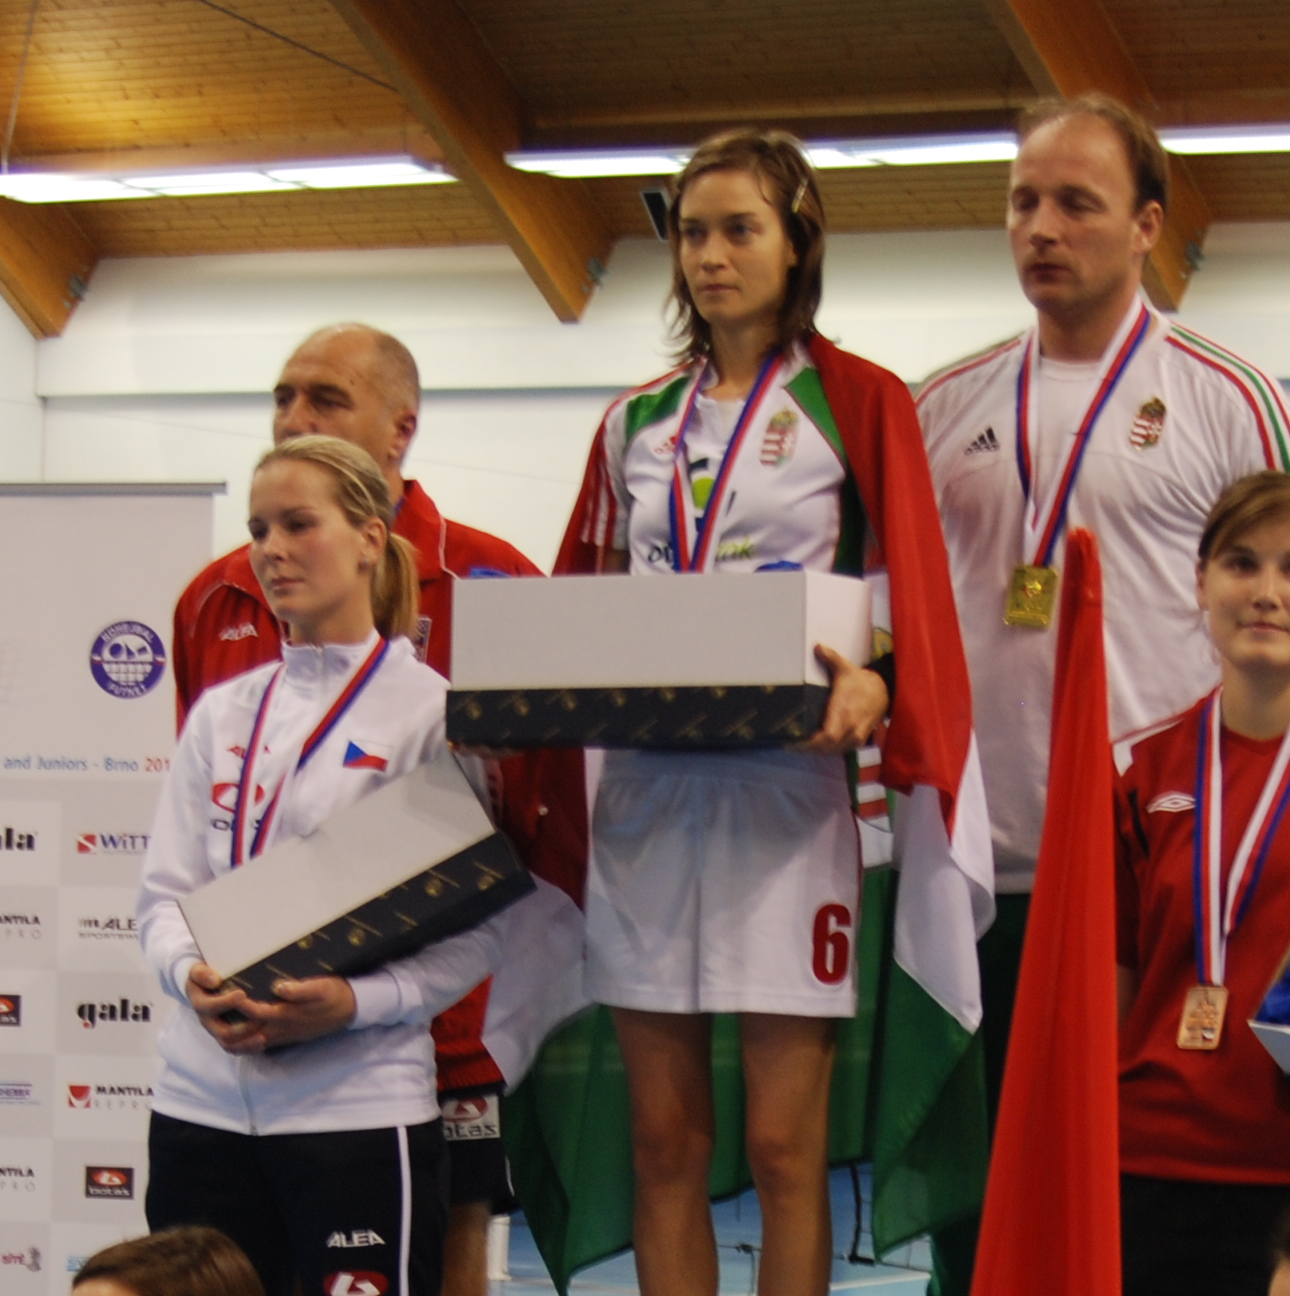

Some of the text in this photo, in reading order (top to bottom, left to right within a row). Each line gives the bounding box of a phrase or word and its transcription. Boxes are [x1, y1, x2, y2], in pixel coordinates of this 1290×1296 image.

[3, 755, 30, 770] and
[37, 755, 88, 772] Juniors
[104, 757, 138, 772] Brno
[144, 757, 171, 772] 201
[100, 832, 151, 850] WiTT
[102, 918, 138, 931] ALE
[812, 903, 852, 986] 6
[76, 998, 151, 1030] gala
[95, 1085, 154, 1098] MANTILA
[326, 1229, 386, 1248] ALEA
